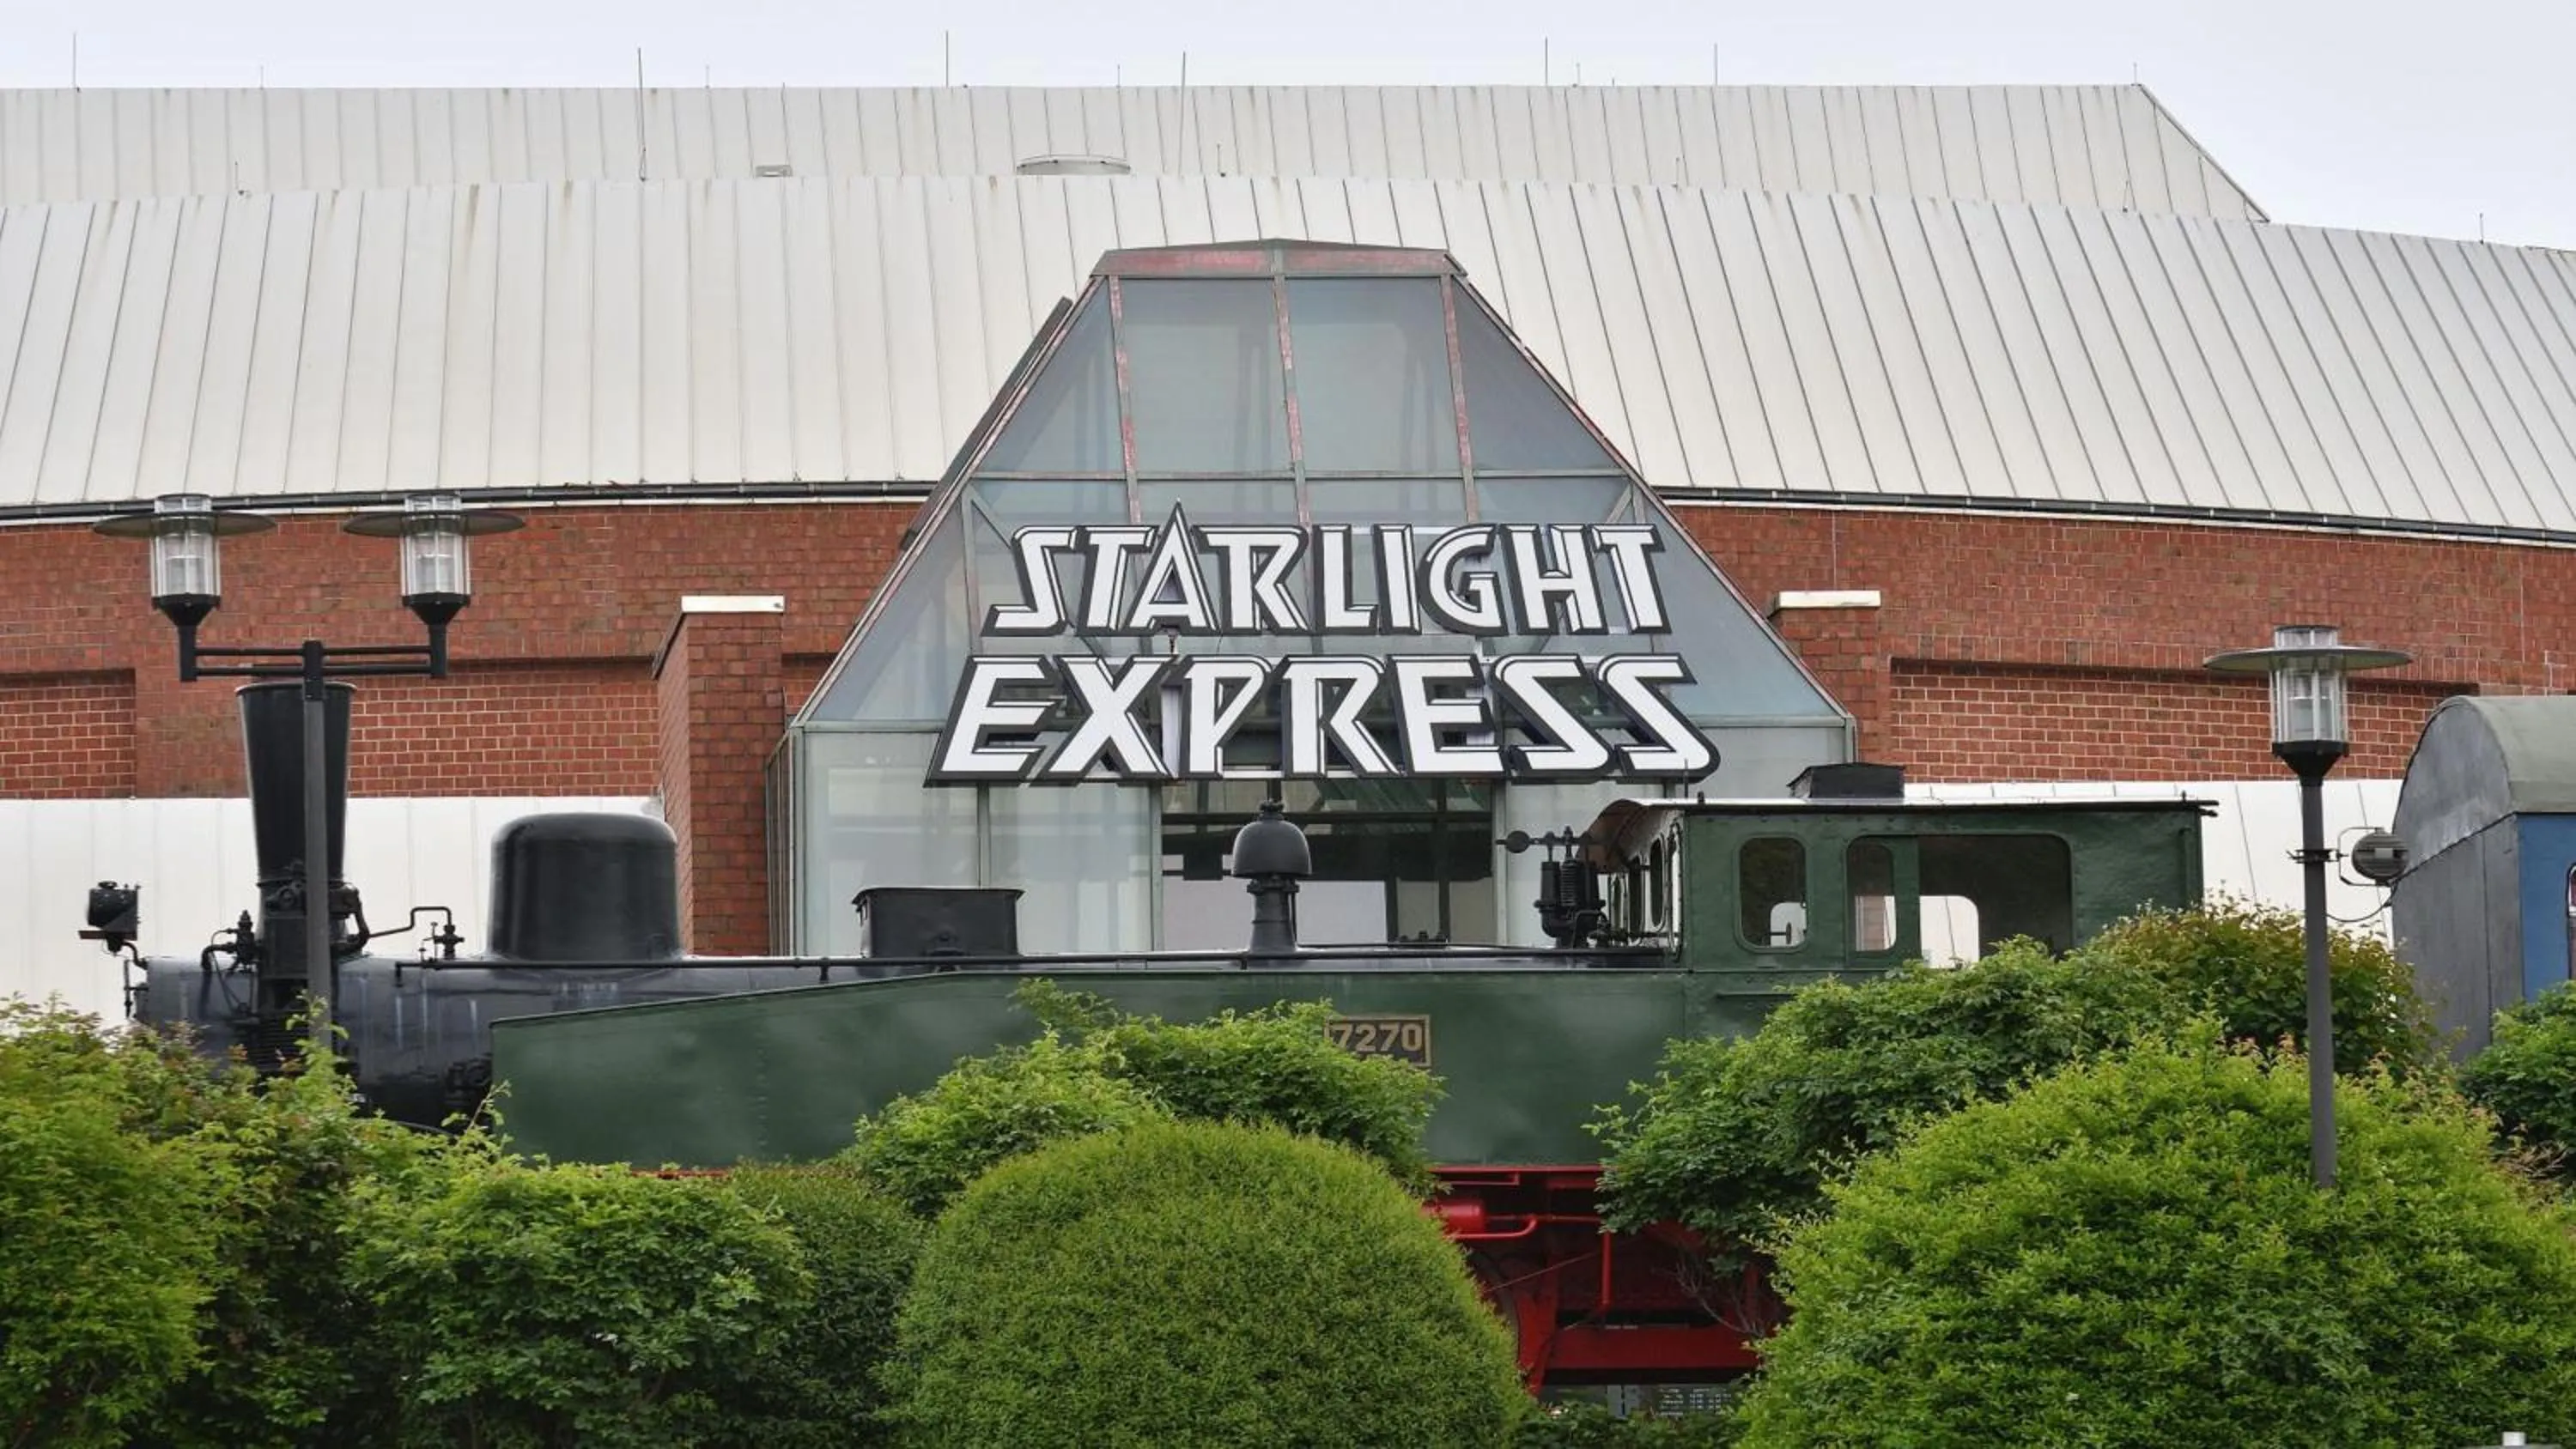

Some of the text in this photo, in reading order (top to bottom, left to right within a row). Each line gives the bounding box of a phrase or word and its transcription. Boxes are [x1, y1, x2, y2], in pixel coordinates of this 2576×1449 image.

[981, 500, 1672, 636] STARLIGHT
[924, 653, 1721, 786] EXPRESS
[1331, 1022, 1423, 1052] 7270
